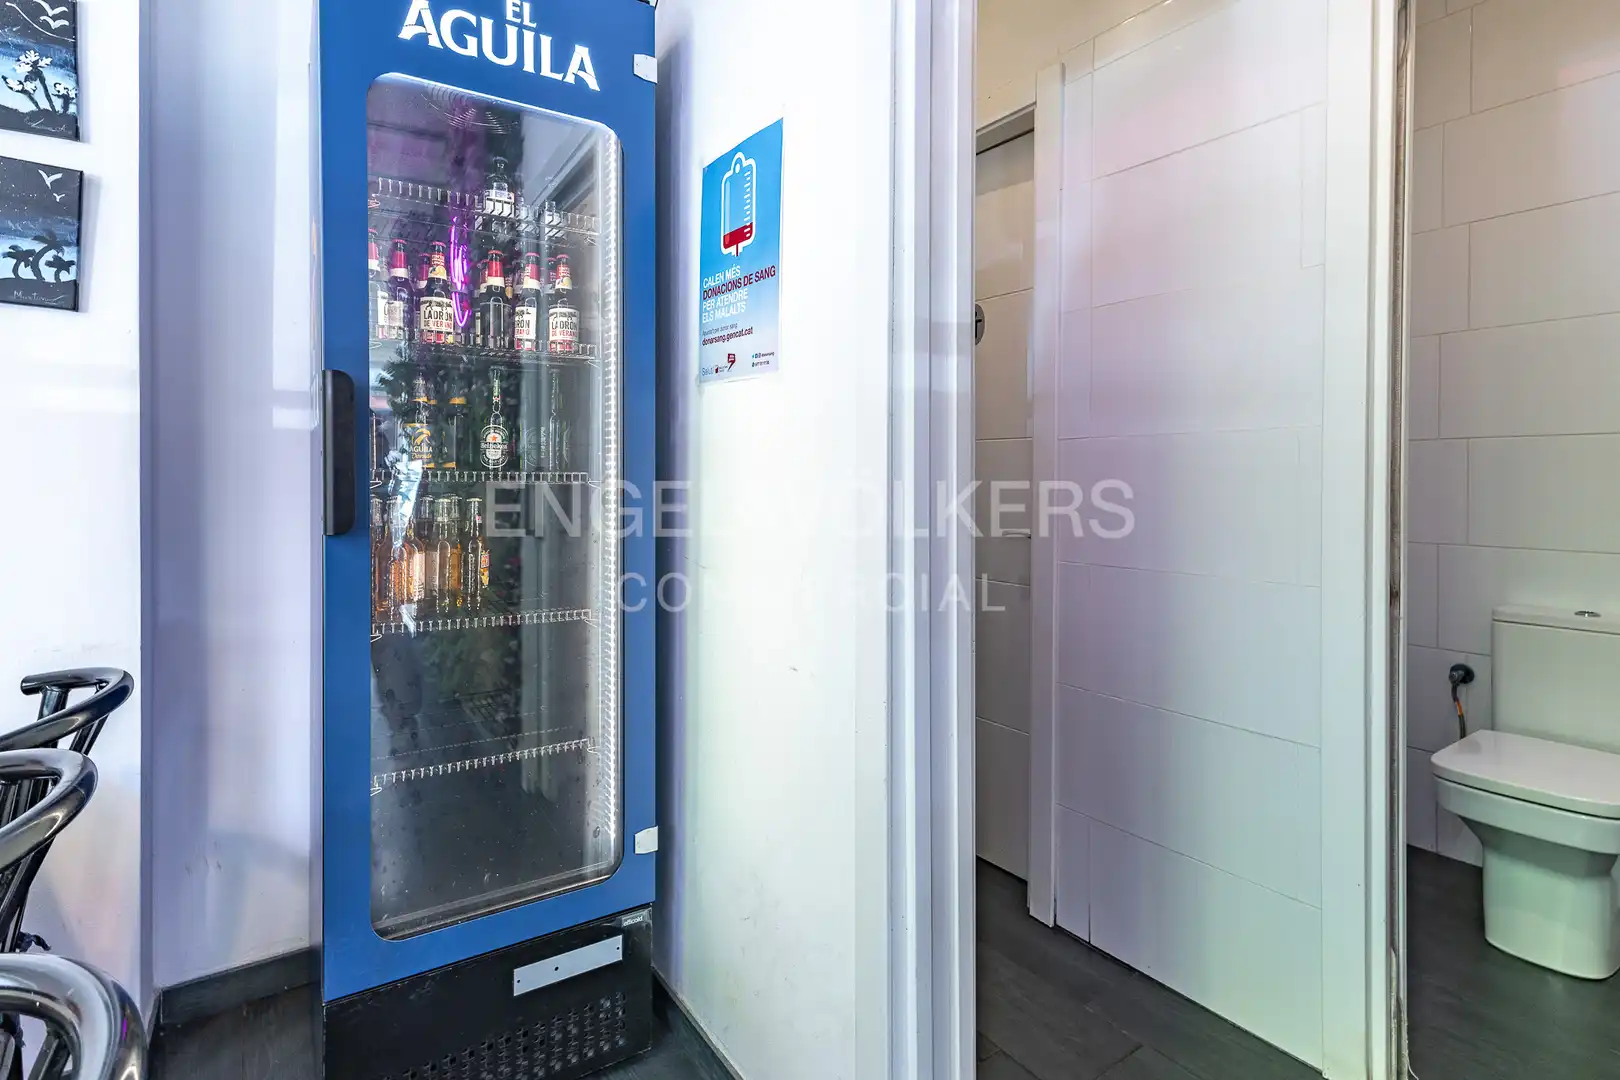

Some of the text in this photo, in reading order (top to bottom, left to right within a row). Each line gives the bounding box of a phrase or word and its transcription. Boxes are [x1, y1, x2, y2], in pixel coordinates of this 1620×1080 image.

[506, 0, 537, 28] EL
[702, 263, 741, 289] CALEN MÉS
[702, 265, 776, 300] DONACIONS DE SANG
[702, 287, 749, 312] PER ATENDRE
[702, 301, 747, 323] ELS MALALTS
[702, 327, 753, 346] donarsang.gencat.cat
